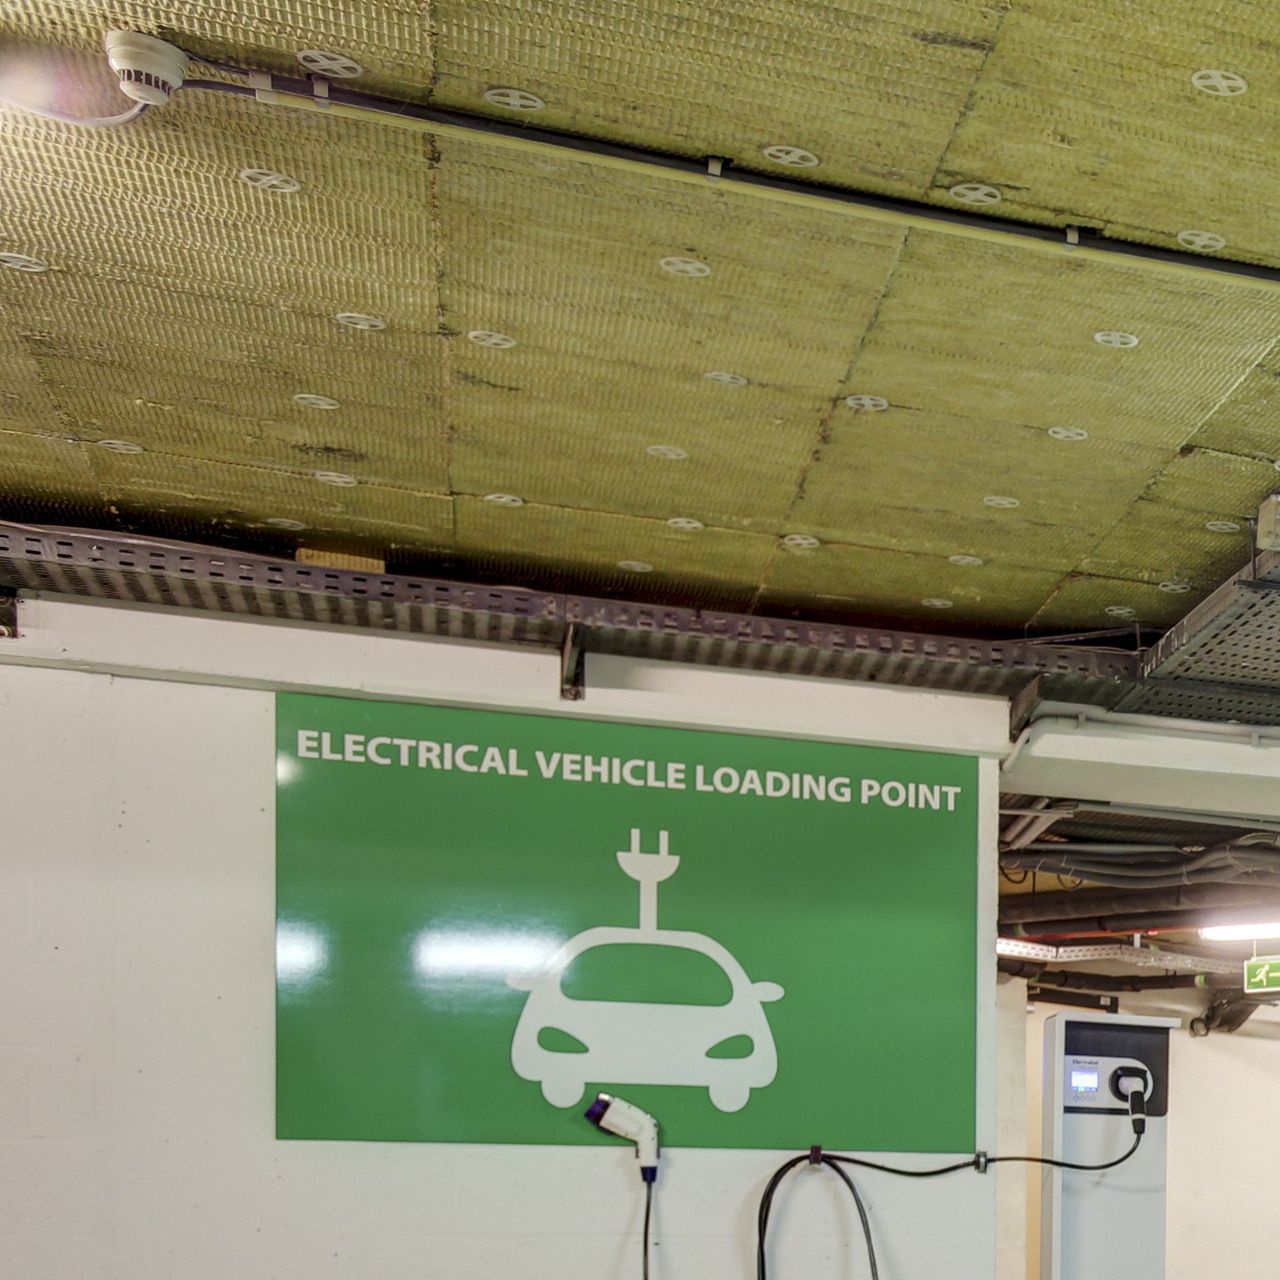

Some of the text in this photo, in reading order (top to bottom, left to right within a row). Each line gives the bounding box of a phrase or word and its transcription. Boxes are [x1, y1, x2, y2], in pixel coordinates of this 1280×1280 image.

[297, 729, 963, 811] ELECTRICAL VEHICLE LOADING POINT
